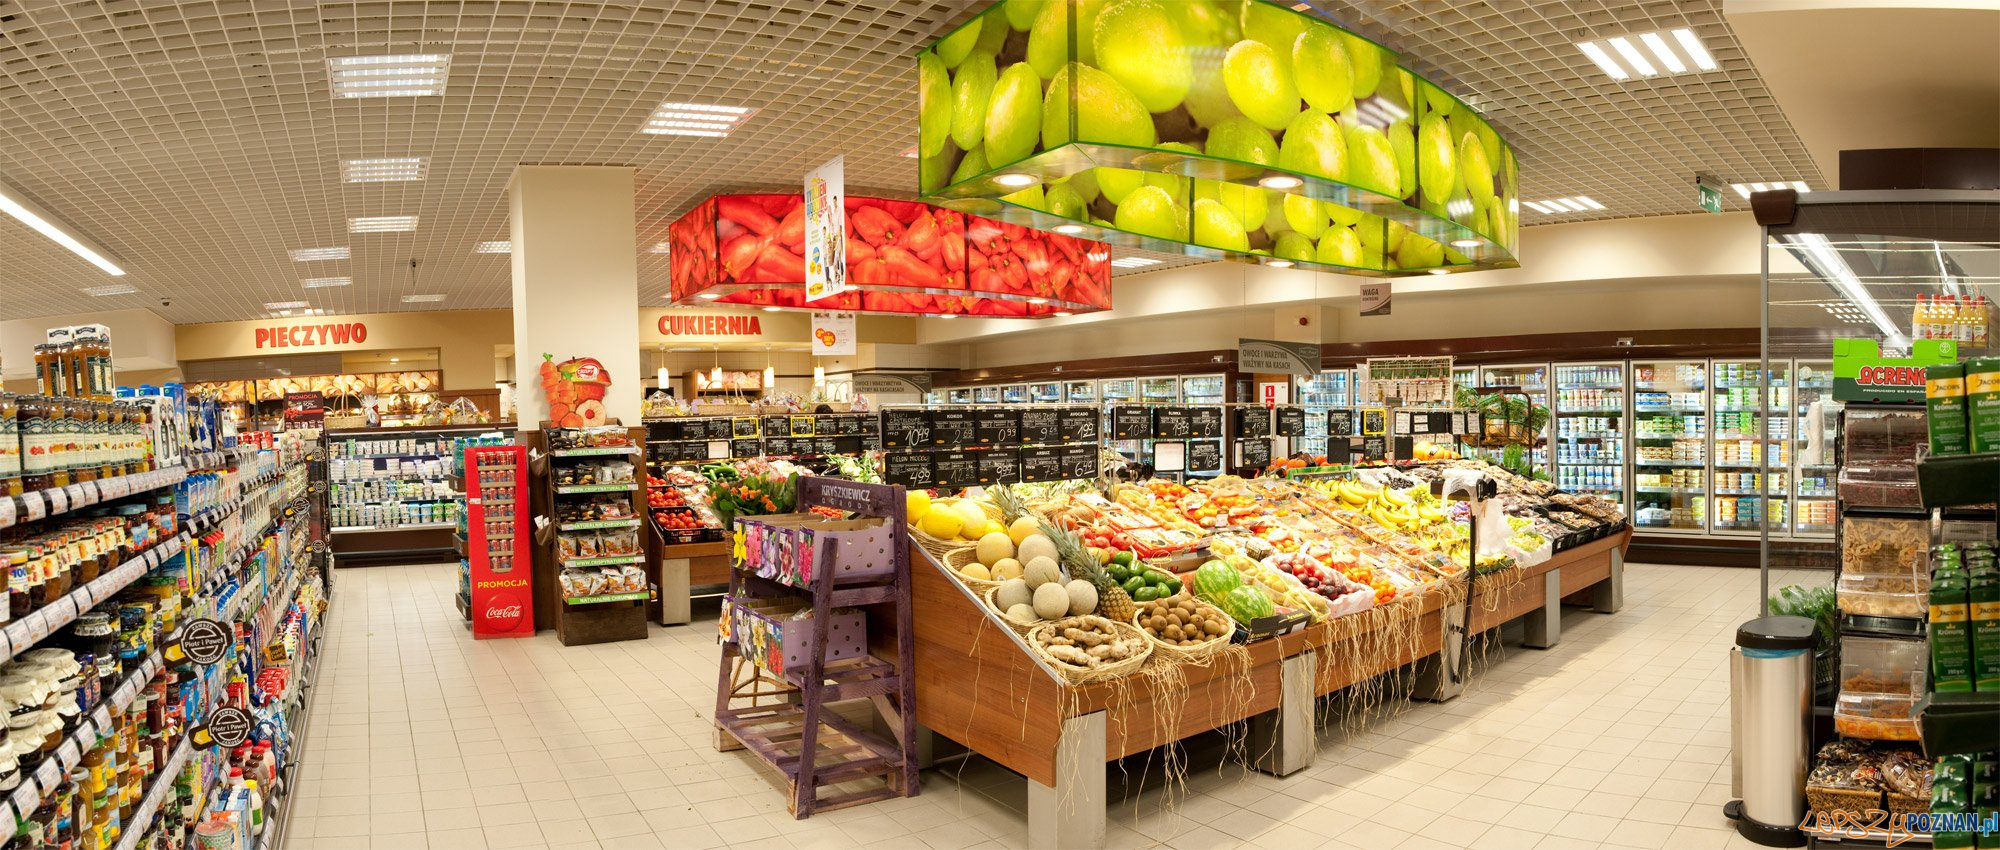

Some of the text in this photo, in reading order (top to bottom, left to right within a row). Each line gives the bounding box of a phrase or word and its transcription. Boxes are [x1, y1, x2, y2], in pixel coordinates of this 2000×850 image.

[1362, 288, 1379, 296] WAGA
[658, 315, 762, 335] CUKIERNIA
[255, 322, 367, 349] PIECZYWO
[1242, 349, 1260, 358] OWOCE
[1264, 350, 1288, 359] WARZYWA
[1242, 359, 1265, 369] WAŻYMY
[1273, 361, 1291, 370] KASACH
[821, 484, 870, 502] KRYSZKIEWICZ
[477, 579, 528, 589] PROMOCJA
[184, 640, 201, 648] Piotr
[211, 725, 226, 733] Piotr
